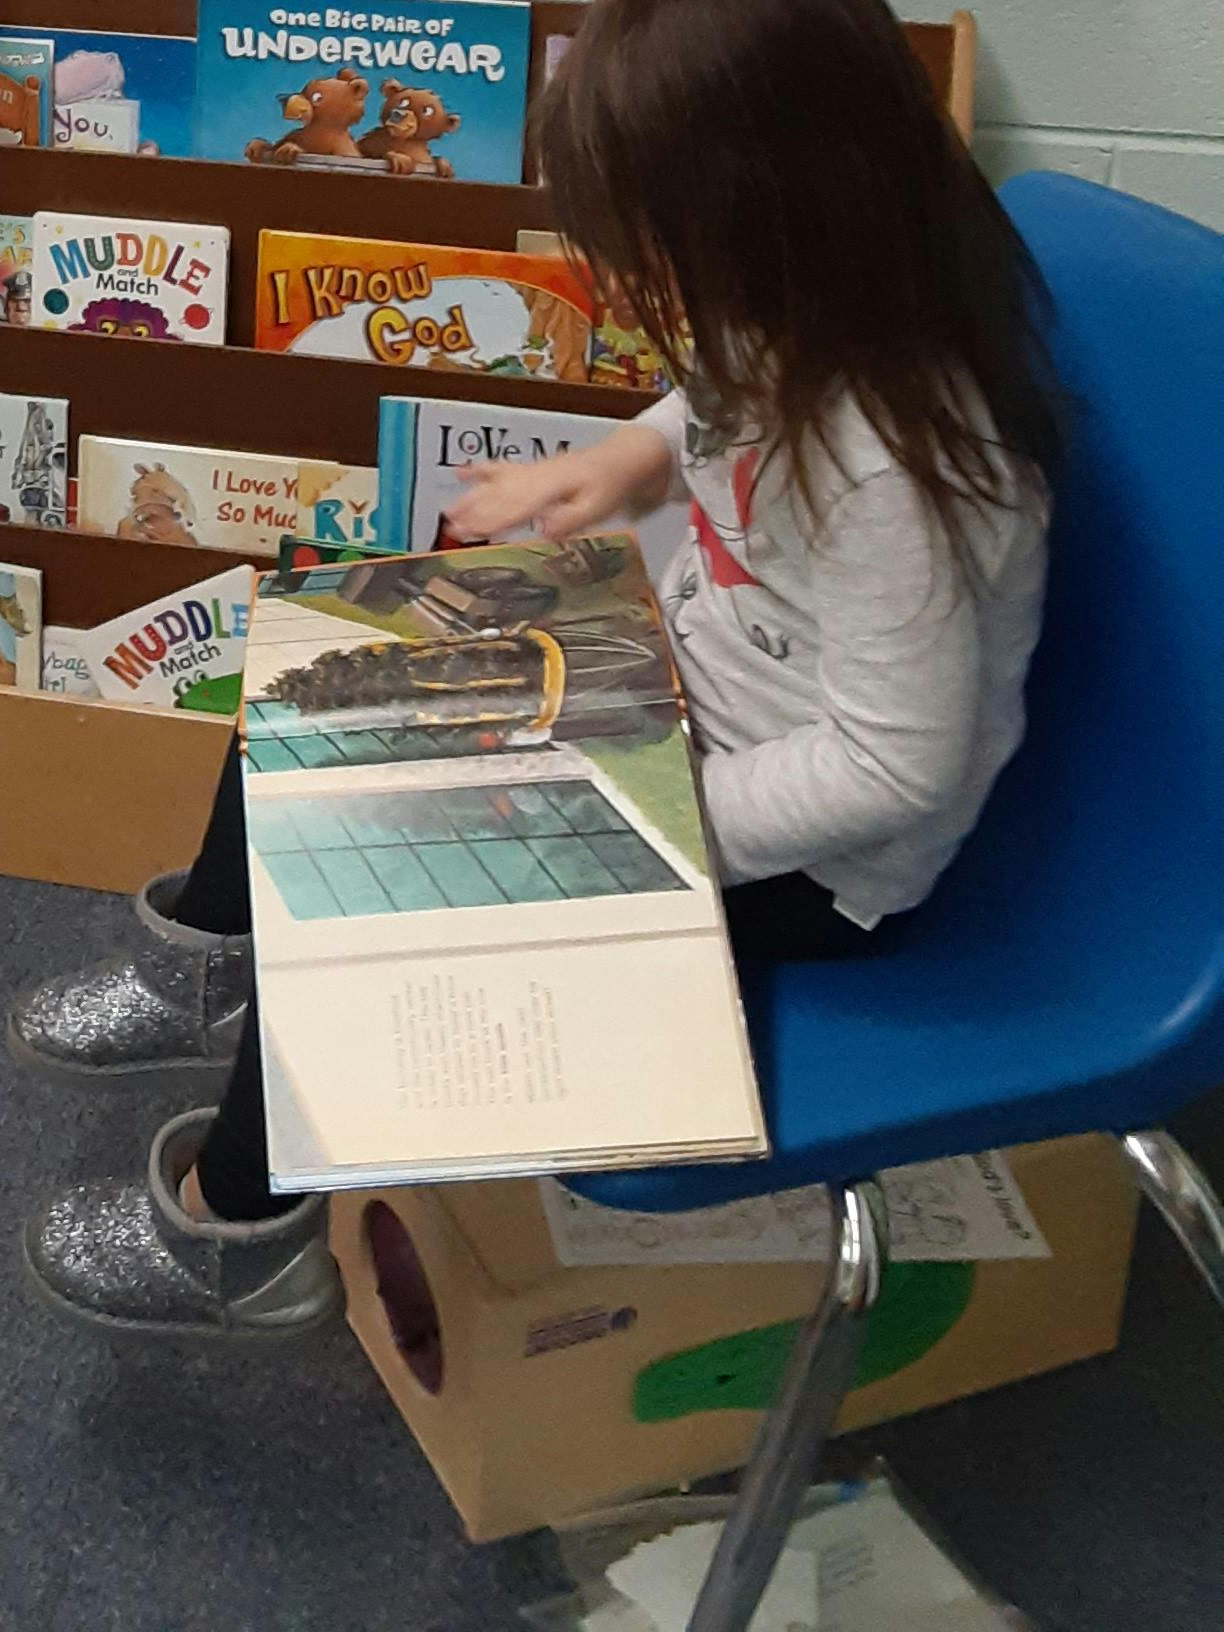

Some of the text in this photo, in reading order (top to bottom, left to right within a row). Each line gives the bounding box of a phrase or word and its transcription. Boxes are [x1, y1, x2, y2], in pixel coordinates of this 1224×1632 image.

[49, 232, 212, 296] MUDDLE
[117, 267, 139, 277] and
[96, 274, 159, 296] Match
[272, 270, 291, 325] I
[365, 305, 473, 367] God
[212, 469, 298, 500] I Love Y
[216, 500, 246, 524] So
[102, 597, 250, 691] MUDDLE
[158, 643, 222, 678] Match
